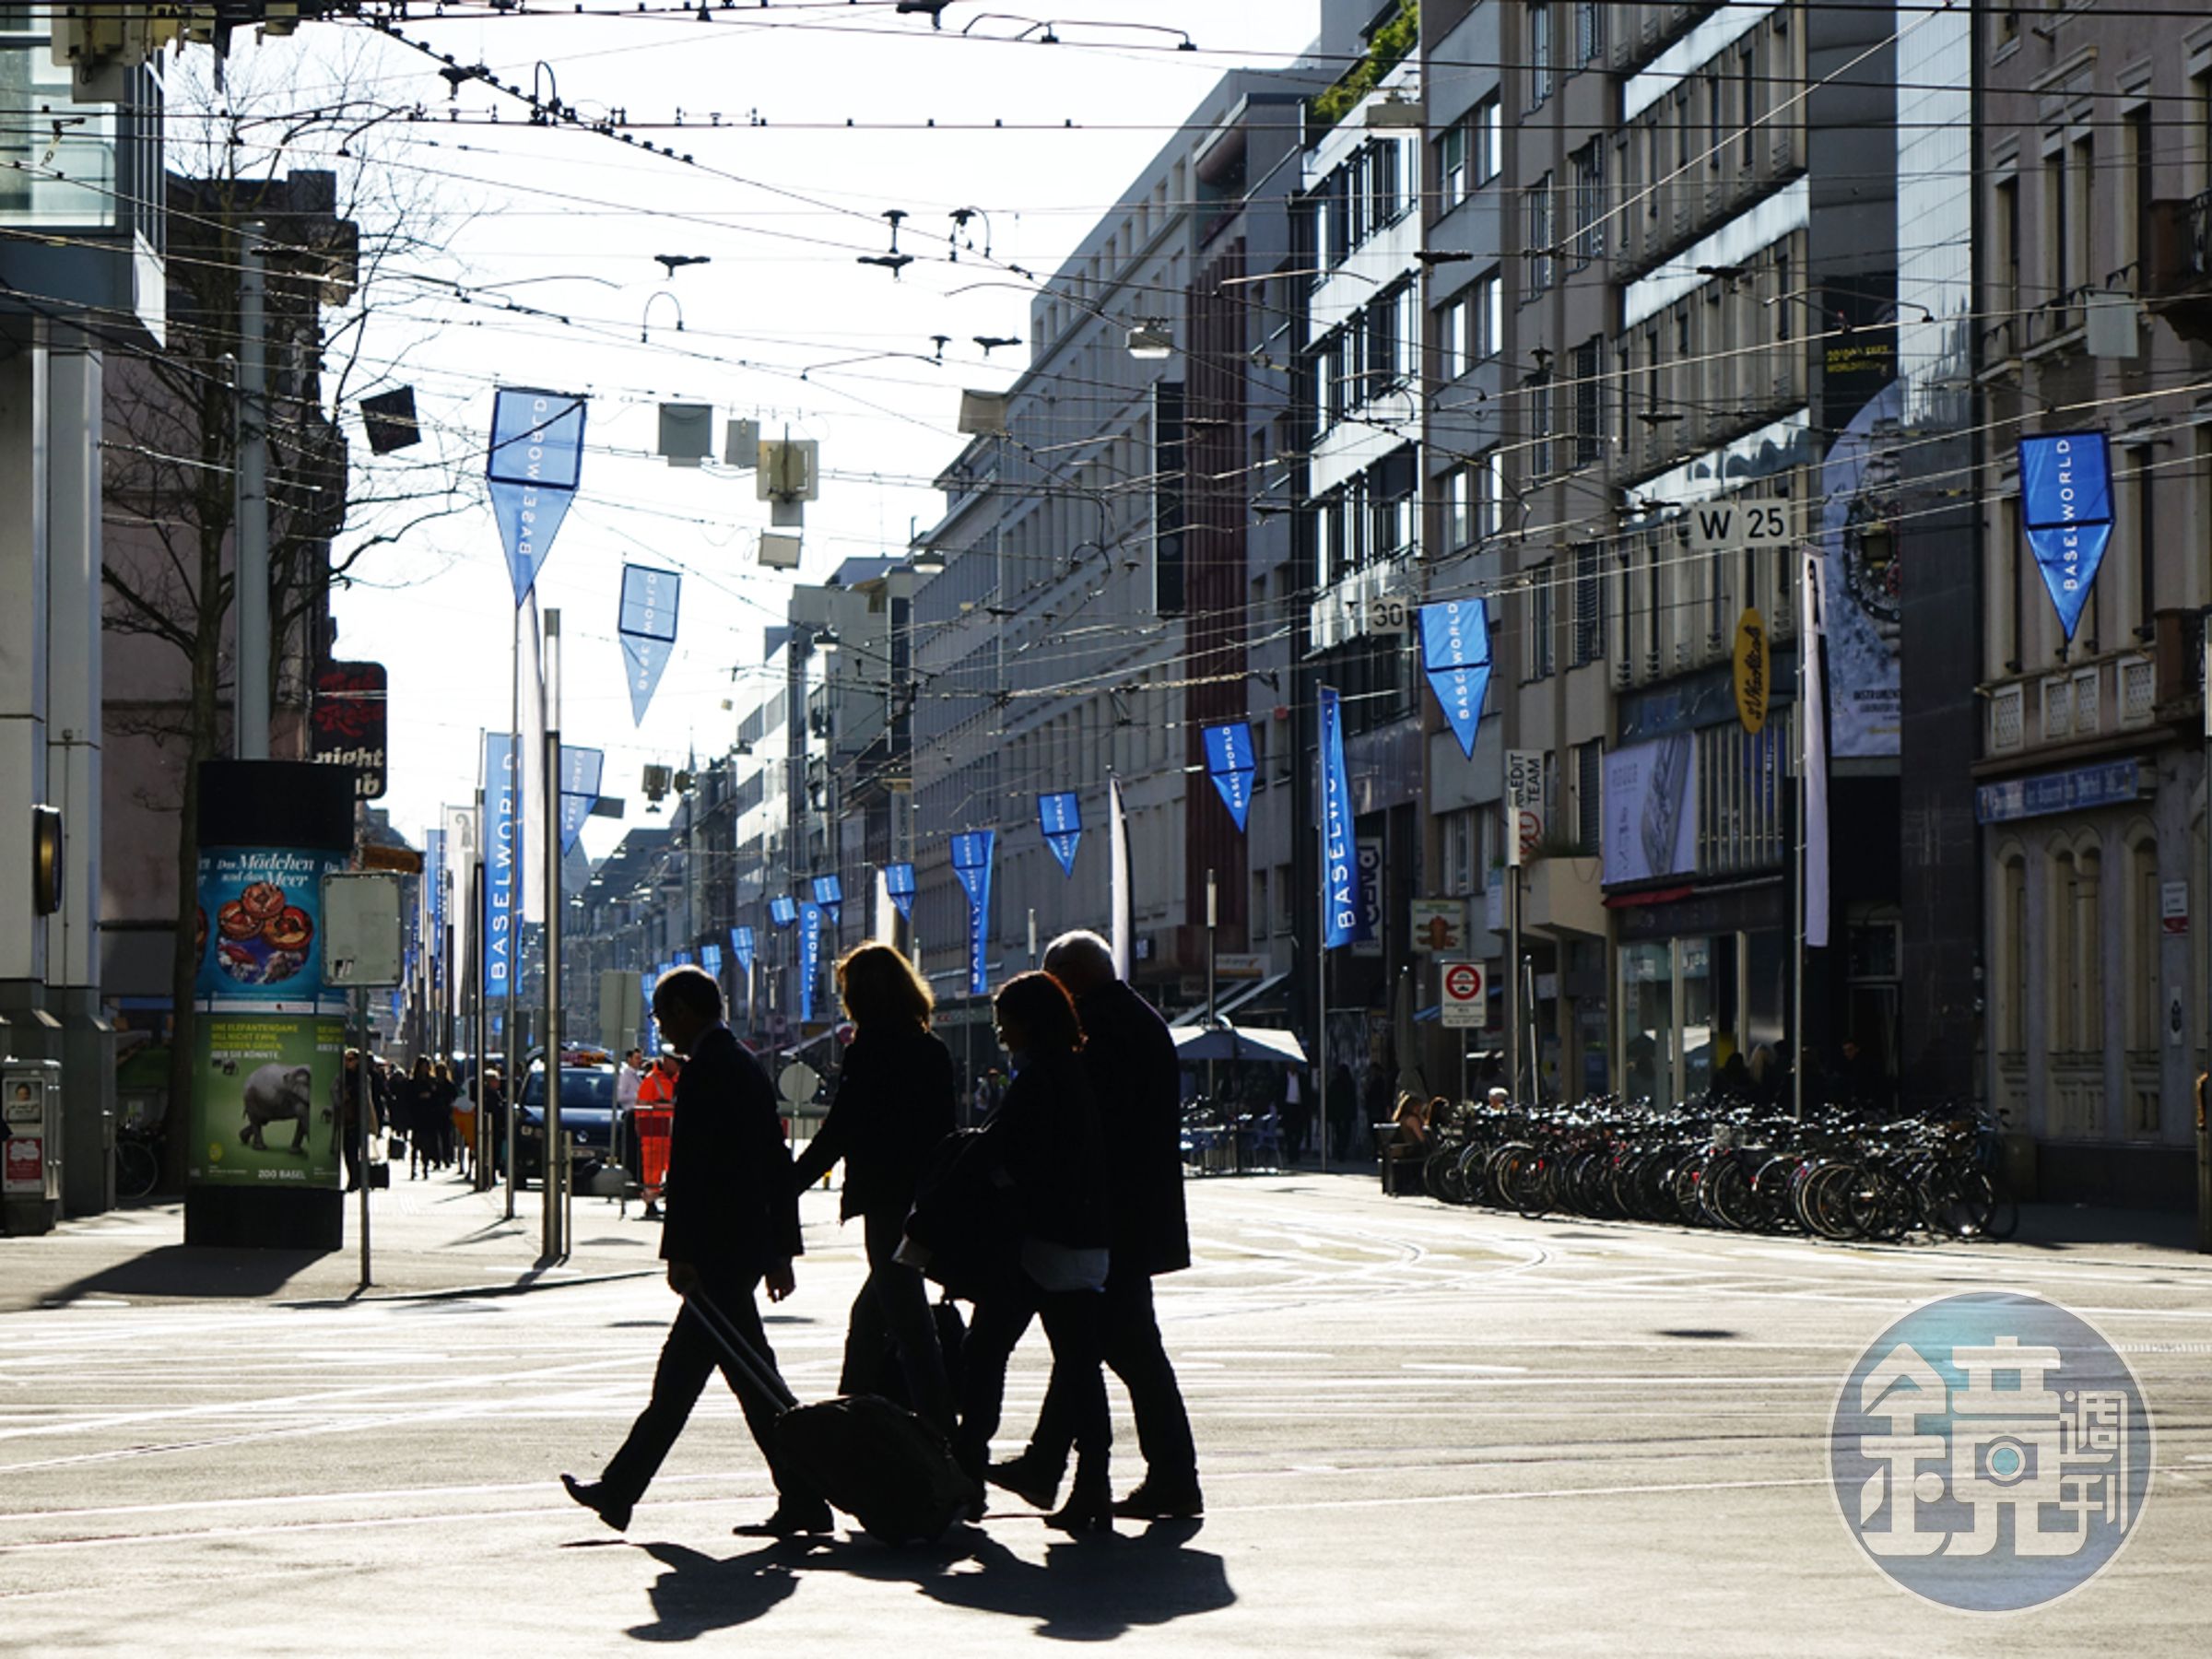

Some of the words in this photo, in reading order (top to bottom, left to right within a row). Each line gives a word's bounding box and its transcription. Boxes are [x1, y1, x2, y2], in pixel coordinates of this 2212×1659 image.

[1700, 509, 1735, 540] W
[1747, 508, 1785, 538] 25
[1373, 603, 1403, 628] 30
[1527, 758, 1540, 805] TEAM
[238, 853, 315, 872] Mädchen
[265, 871, 310, 888] Meer
[257, 1169, 276, 1180] ZOO
[278, 1169, 307, 1181] BASEL
